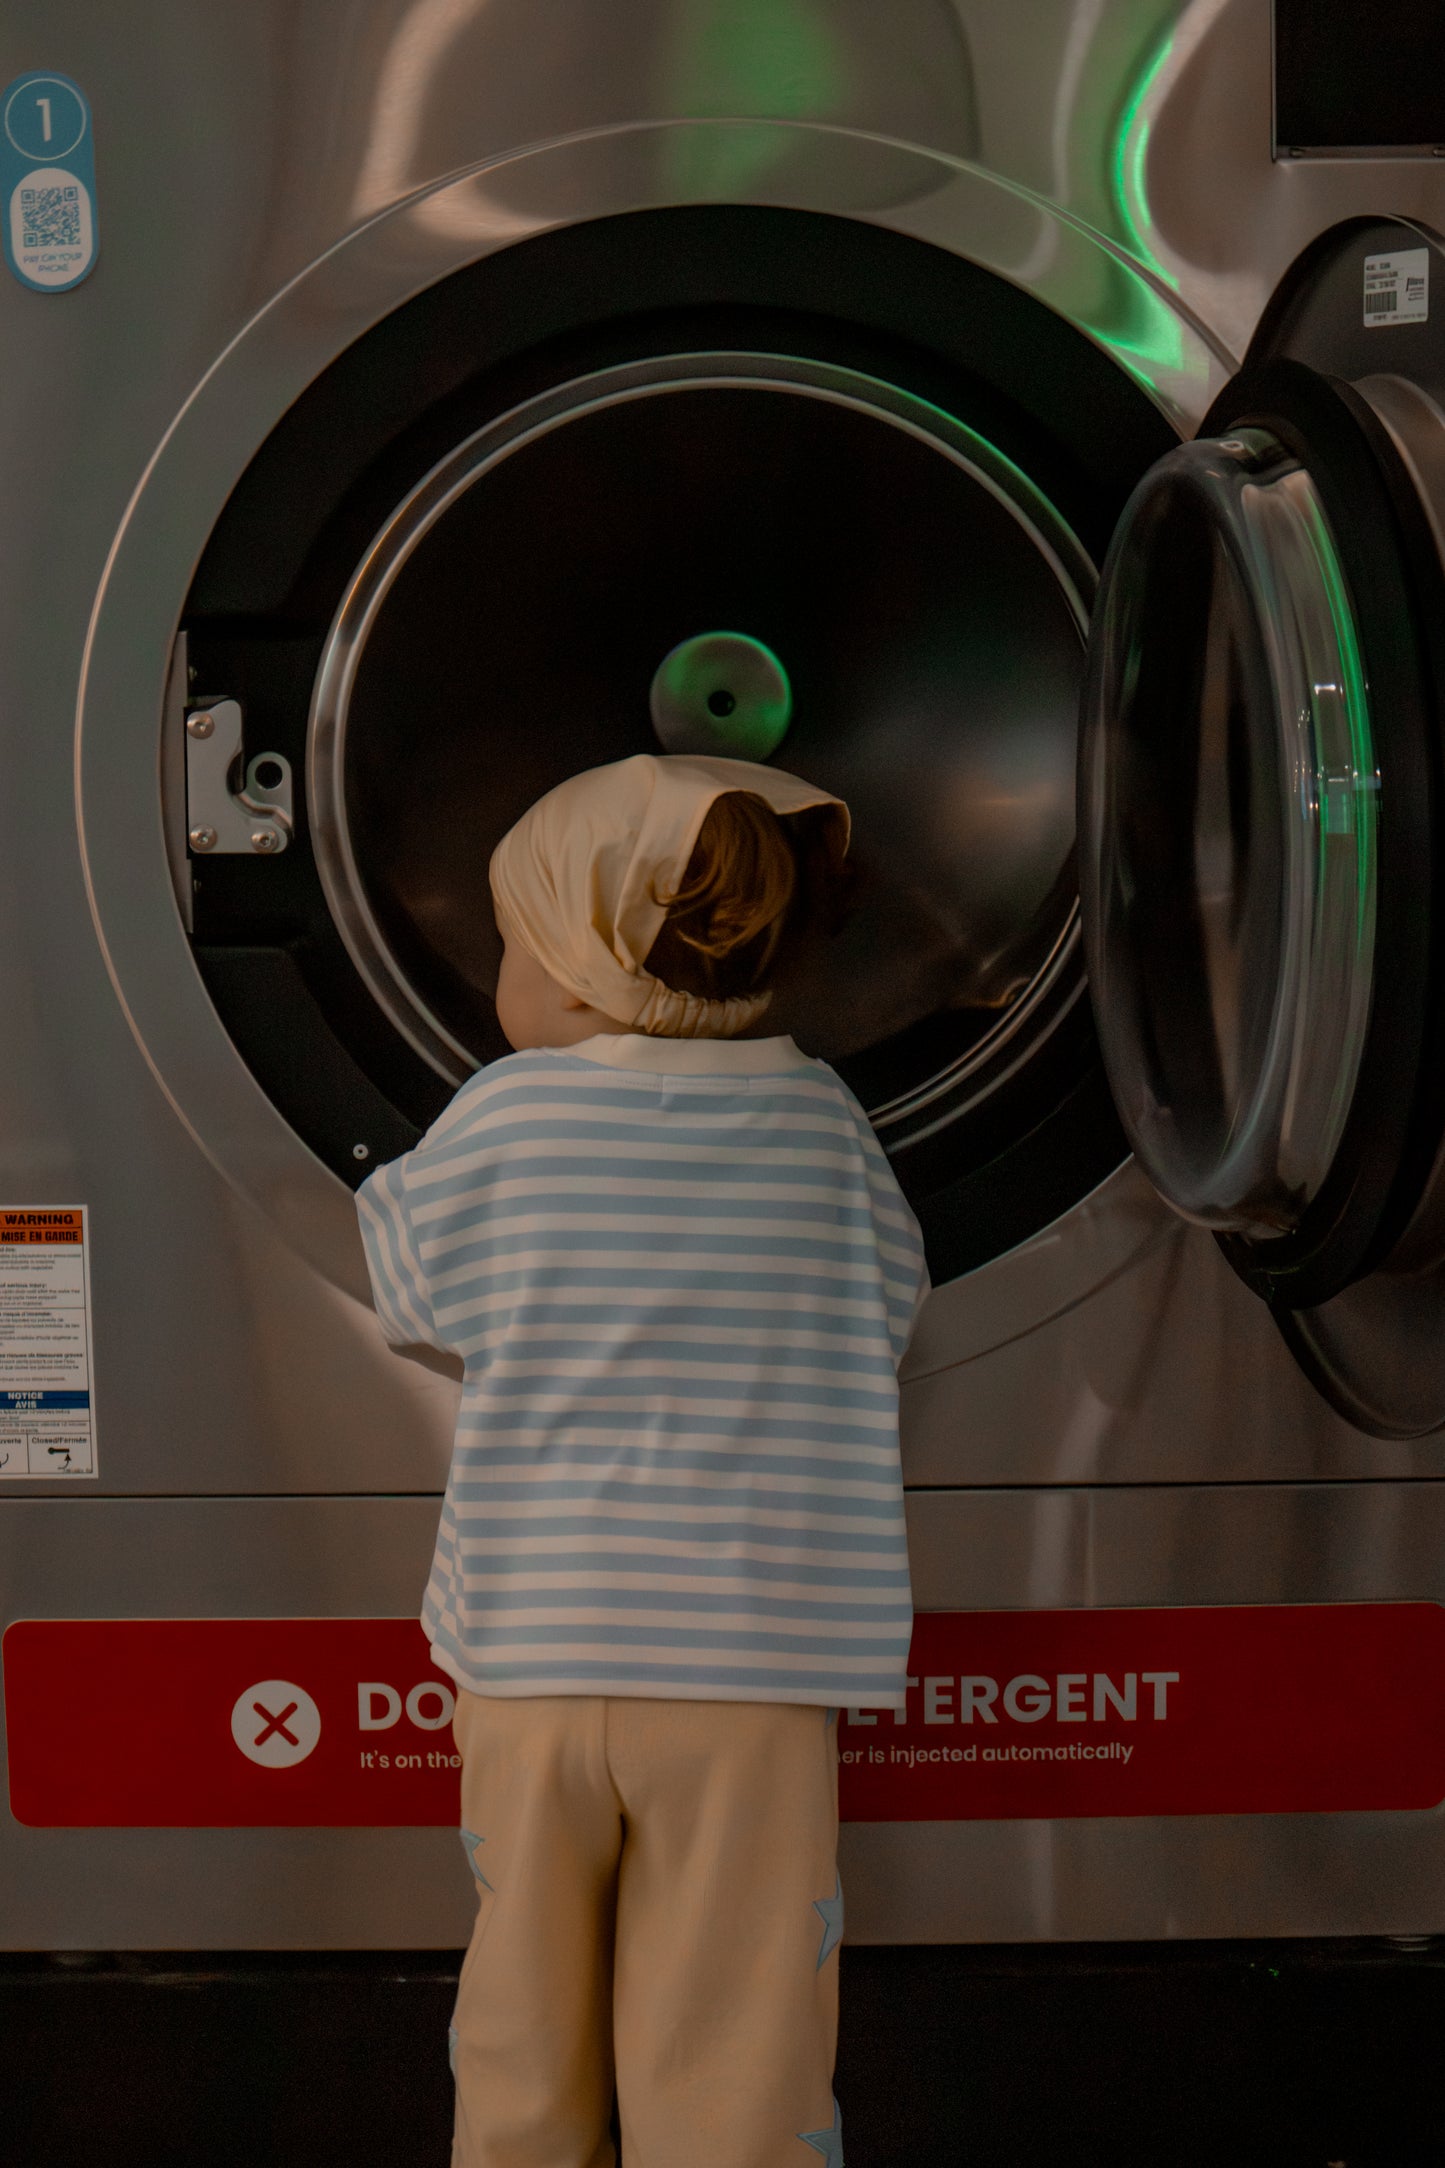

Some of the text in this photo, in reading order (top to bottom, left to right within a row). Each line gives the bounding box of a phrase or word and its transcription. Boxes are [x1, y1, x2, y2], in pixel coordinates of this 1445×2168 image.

[35, 98, 52, 142] 1
[5, 1214, 74, 1225] WARNING
[1, 1231, 78, 1242] MISE EN GARDE
[7, 1392, 44, 1400] NOTICE
[15, 1400, 37, 1408] AVIS
[357, 1681, 456, 1731] DO
[395, 1755, 421, 1769] on
[427, 1751, 462, 1769] the
[838, 1741, 1134, 1768] er is injected automatically
